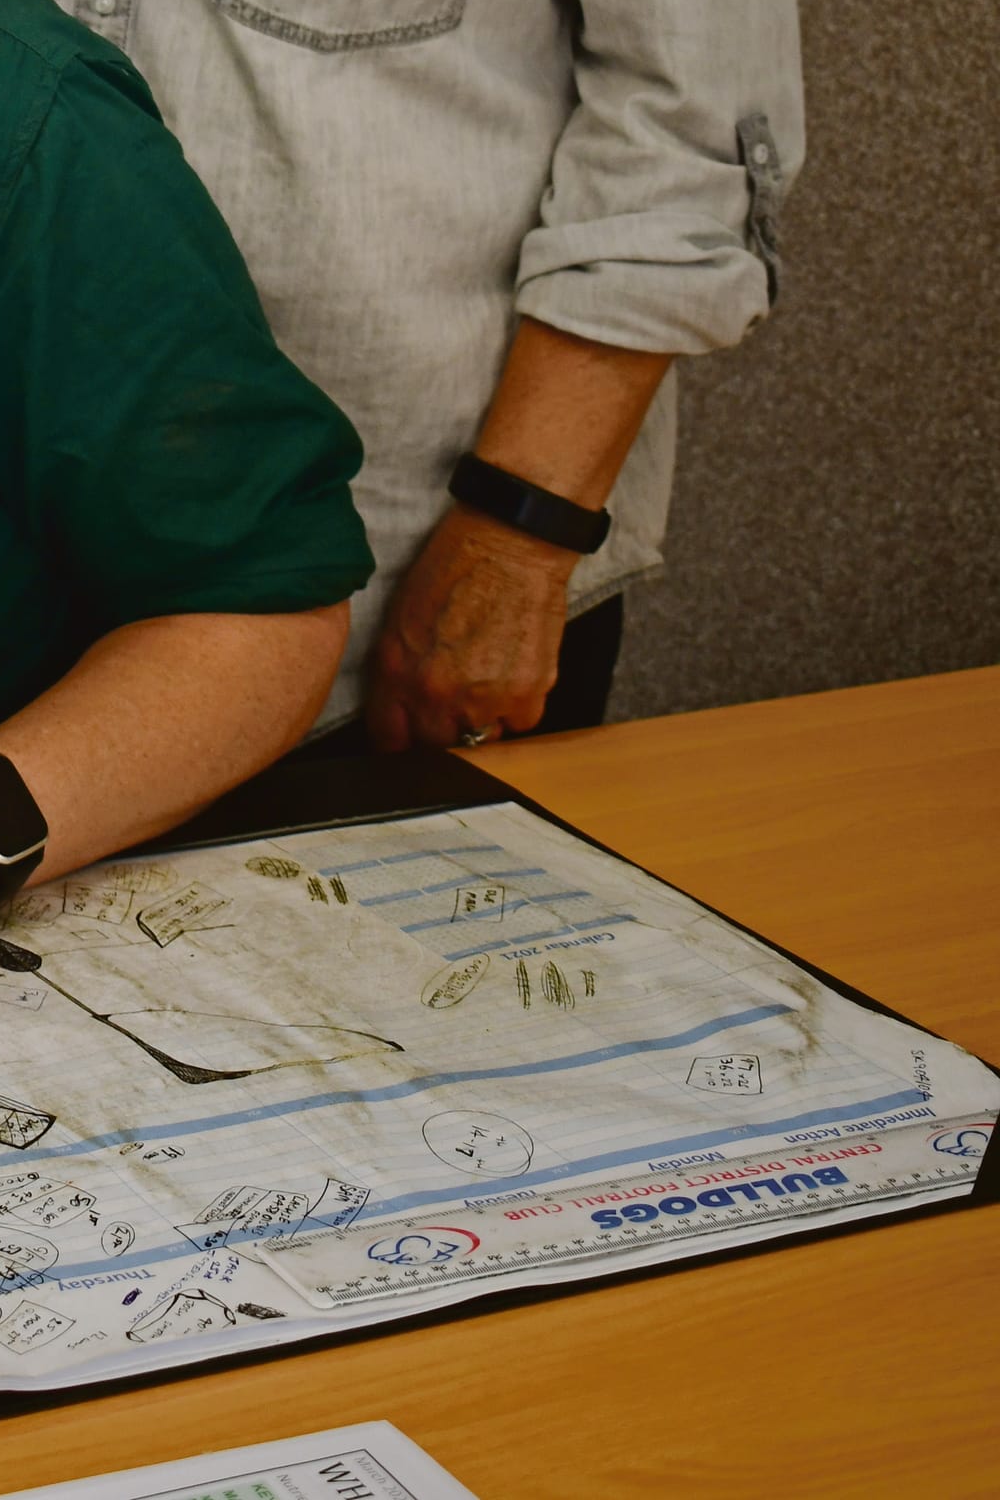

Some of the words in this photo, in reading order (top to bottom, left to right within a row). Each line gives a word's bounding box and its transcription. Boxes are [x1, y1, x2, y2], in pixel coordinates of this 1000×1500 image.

[499, 947, 542, 962] 2021
[544, 931, 616, 953] Calendar
[844, 1106, 936, 1132] Immediate
[784, 1124, 841, 1145] Action
[647, 1151, 725, 1174] Monday
[785, 1142, 883, 1168] CENTRAL
[683, 1161, 783, 1189] DISTRICT
[566, 1180, 679, 1209] FOOTBALL
[590, 1165, 850, 1231] BULLDOGS
[503, 1201, 564, 1222] CLUB
[57, 1268, 157, 1293] Thursday
[219, 1256, 240, 1284] JACK
[354, 1456, 387, 1485] March
